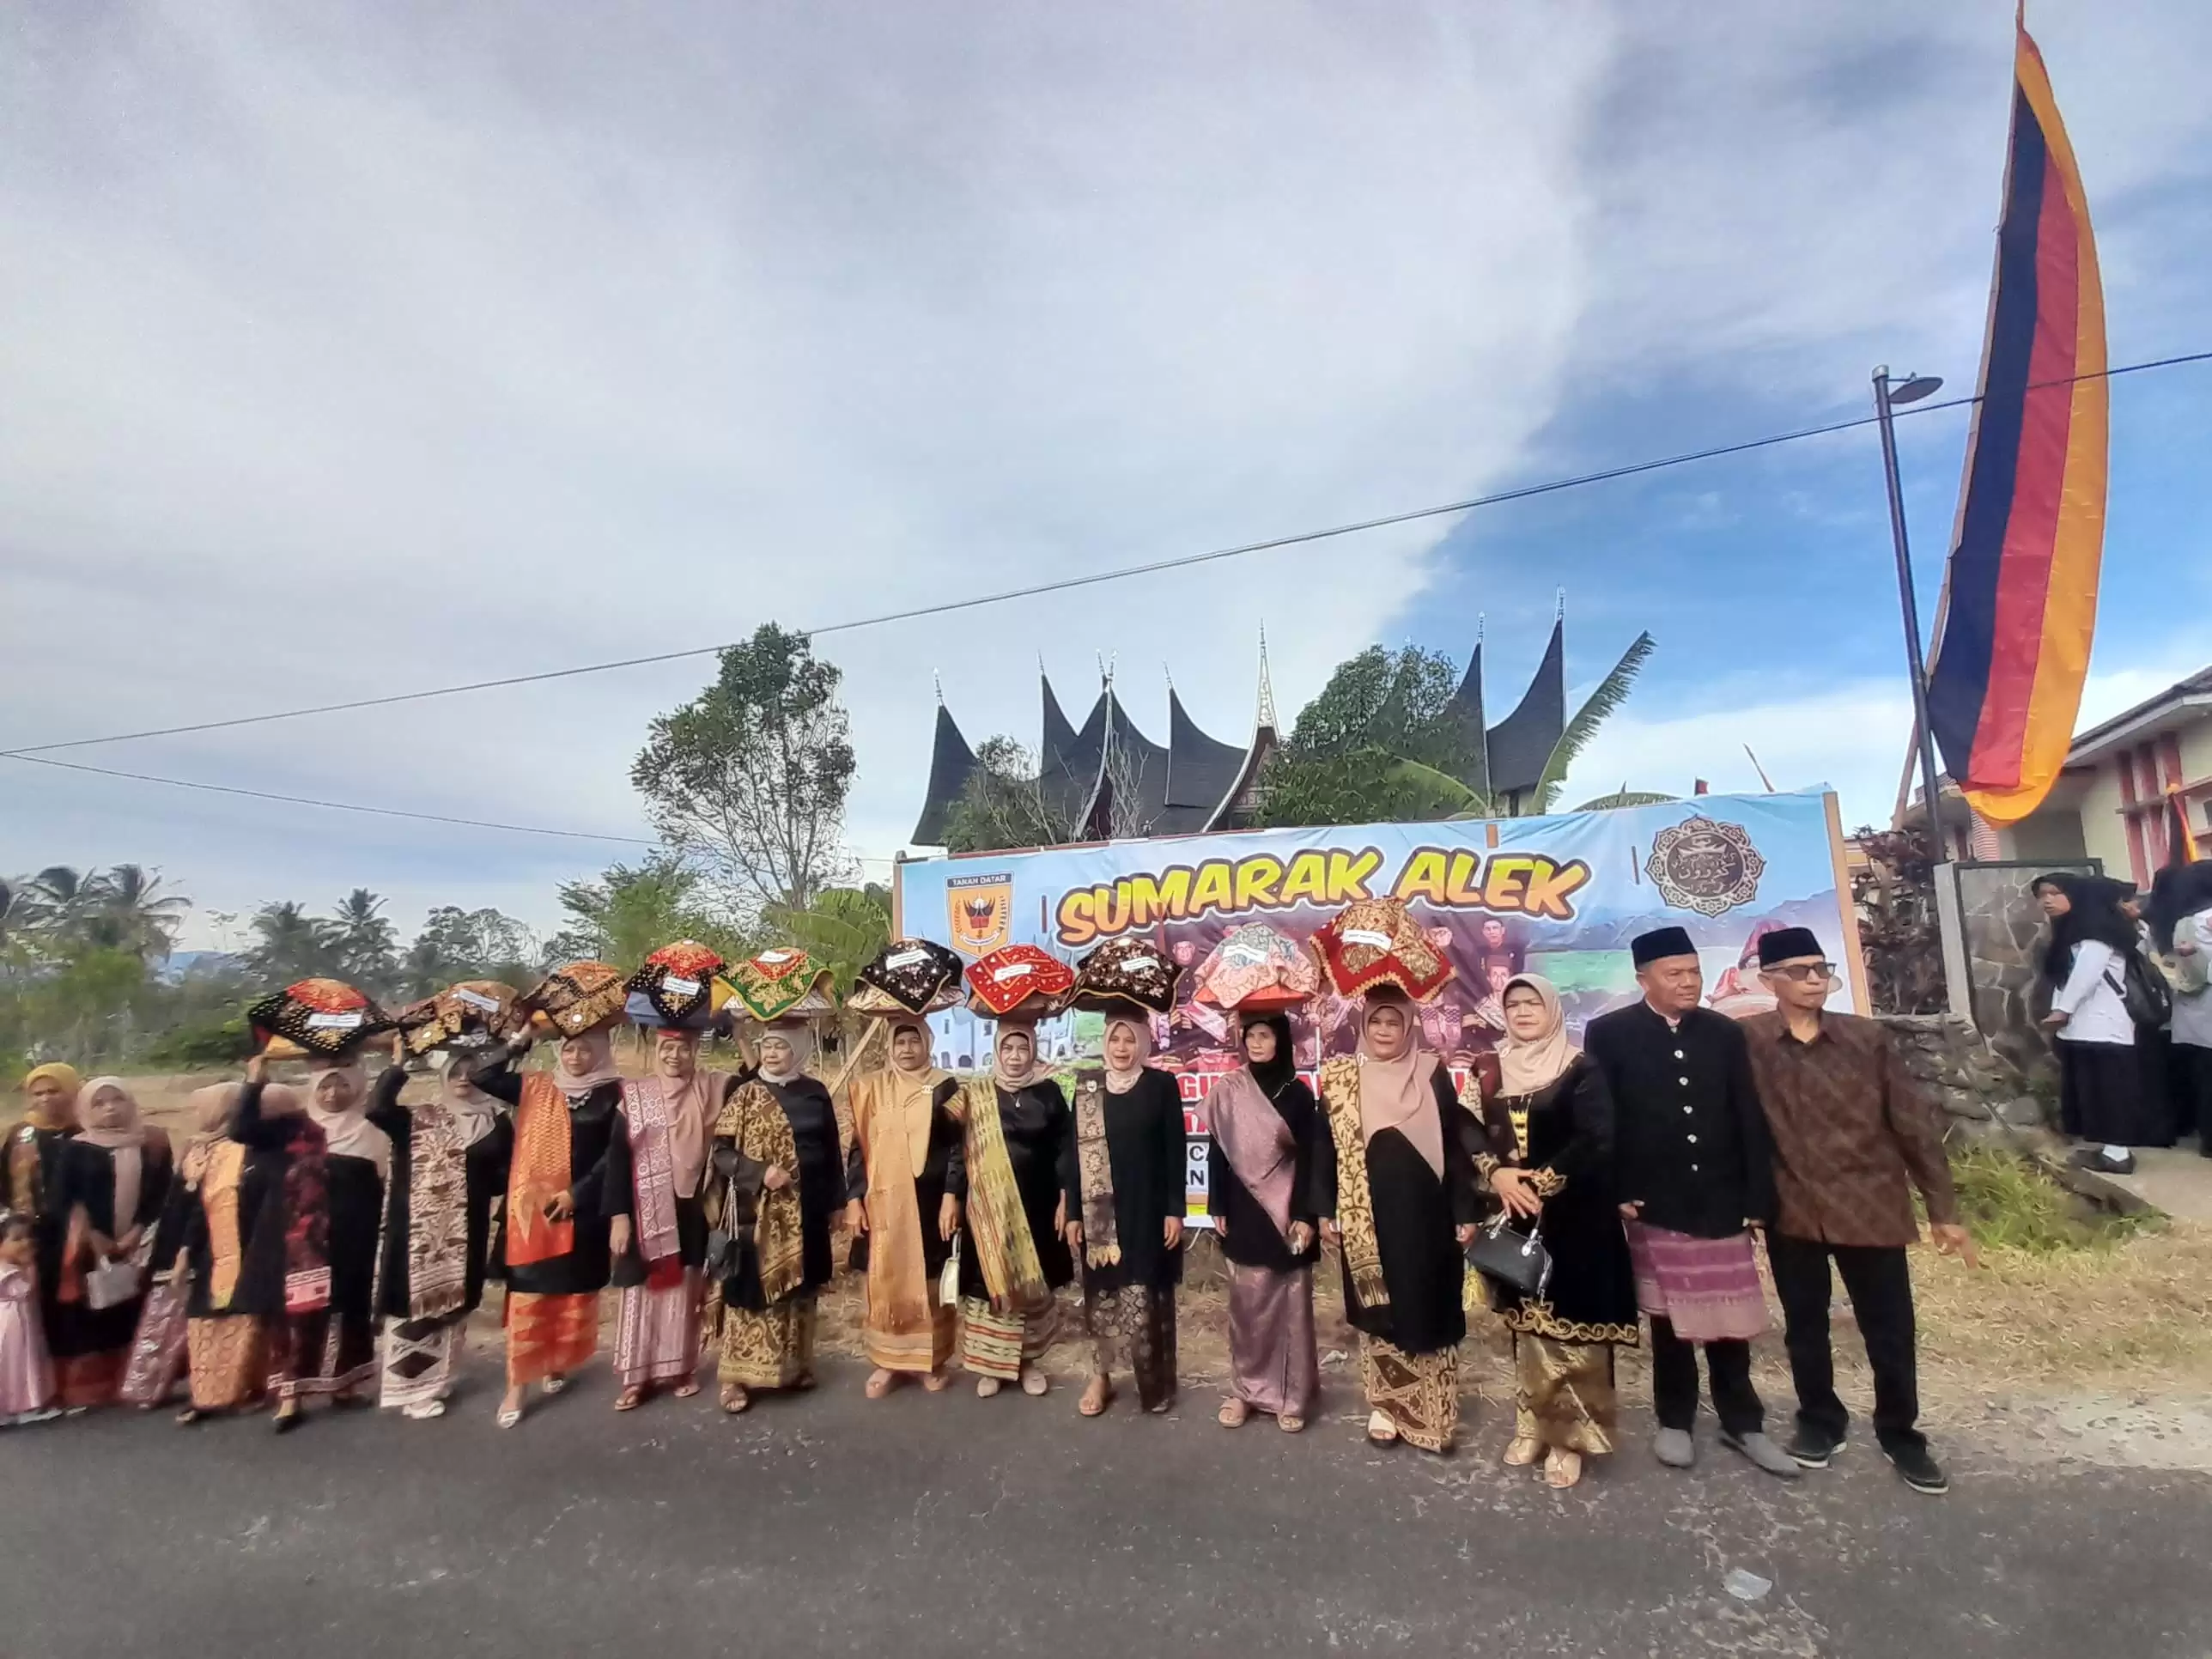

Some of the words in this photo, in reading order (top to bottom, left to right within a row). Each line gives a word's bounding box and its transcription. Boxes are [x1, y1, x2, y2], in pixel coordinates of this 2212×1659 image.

[952, 878, 979, 886] TANAH
[980, 874, 1006, 884] DATAR
[1056, 848, 1382, 944] SUMARAK
[1392, 848, 1586, 917] ALEK
